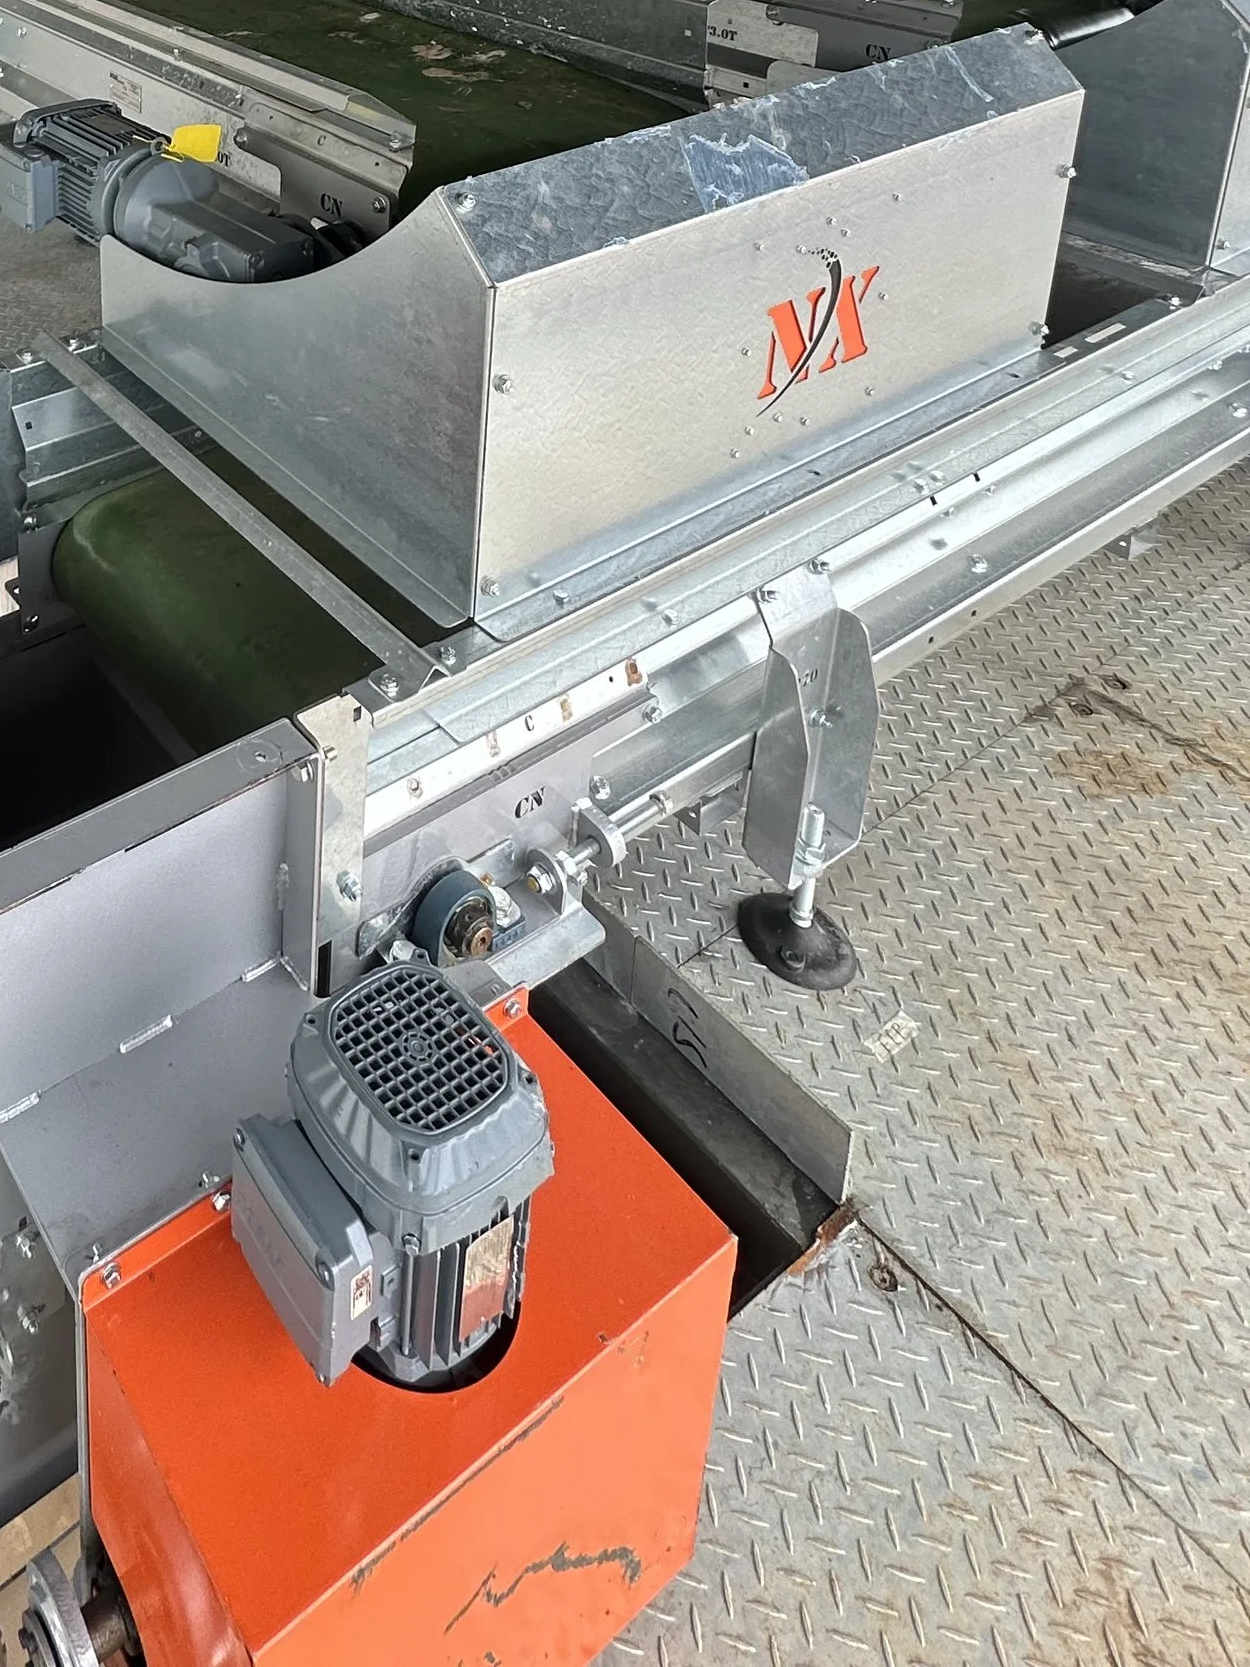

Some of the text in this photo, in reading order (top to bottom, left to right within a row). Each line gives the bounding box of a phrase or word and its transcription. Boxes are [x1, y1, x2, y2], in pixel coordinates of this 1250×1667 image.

[865, 43, 892, 61] CN
[320, 193, 343, 218] CN
[524, 714, 535, 732] C
[514, 785, 546, 819] CN
